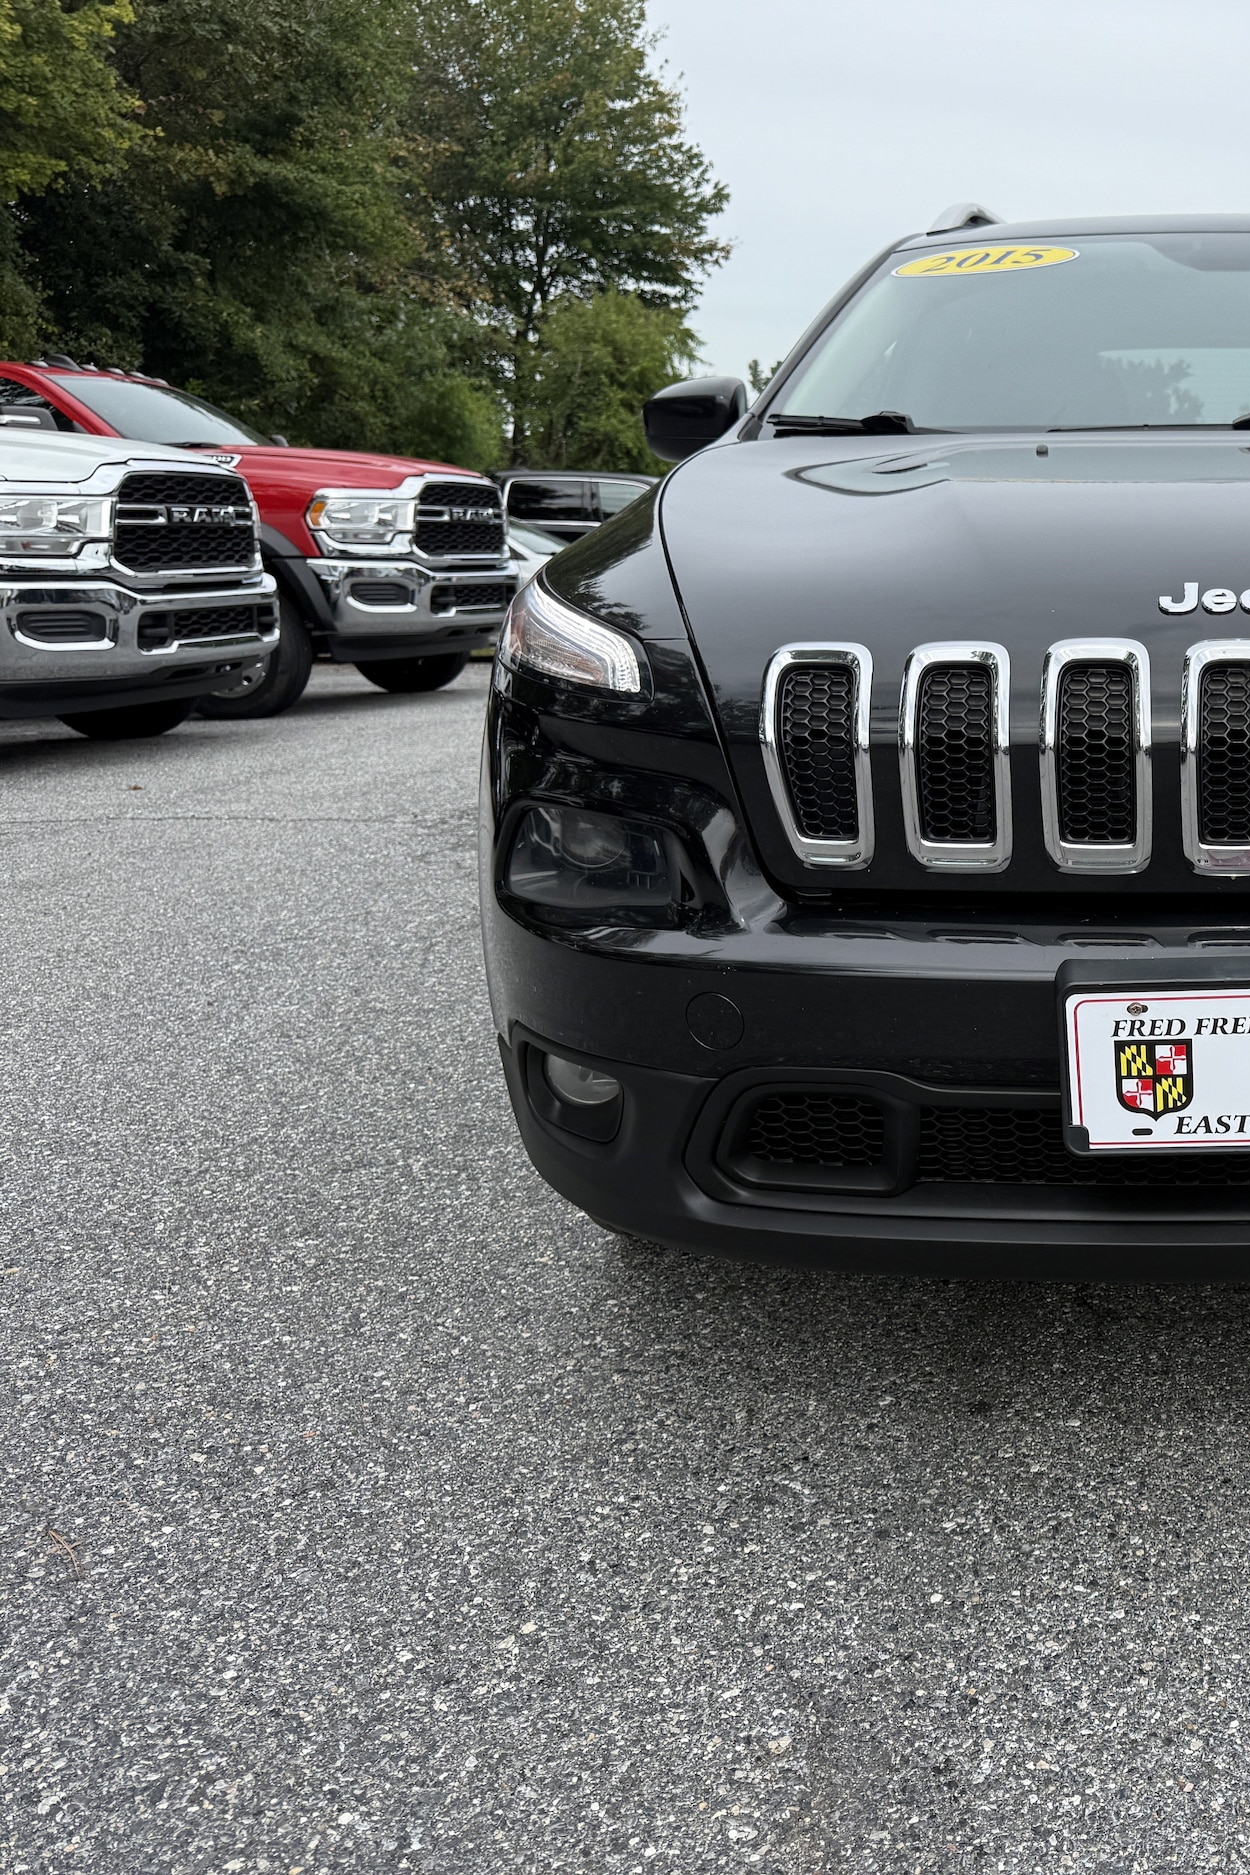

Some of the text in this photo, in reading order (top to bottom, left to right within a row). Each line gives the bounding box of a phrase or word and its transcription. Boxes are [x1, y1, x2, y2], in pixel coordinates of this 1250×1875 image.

[921, 249, 1051, 273] 2015
[170, 504, 237, 526] RAM
[451, 507, 494, 525] RAM
[1111, 1017, 1186, 1037] FRED
